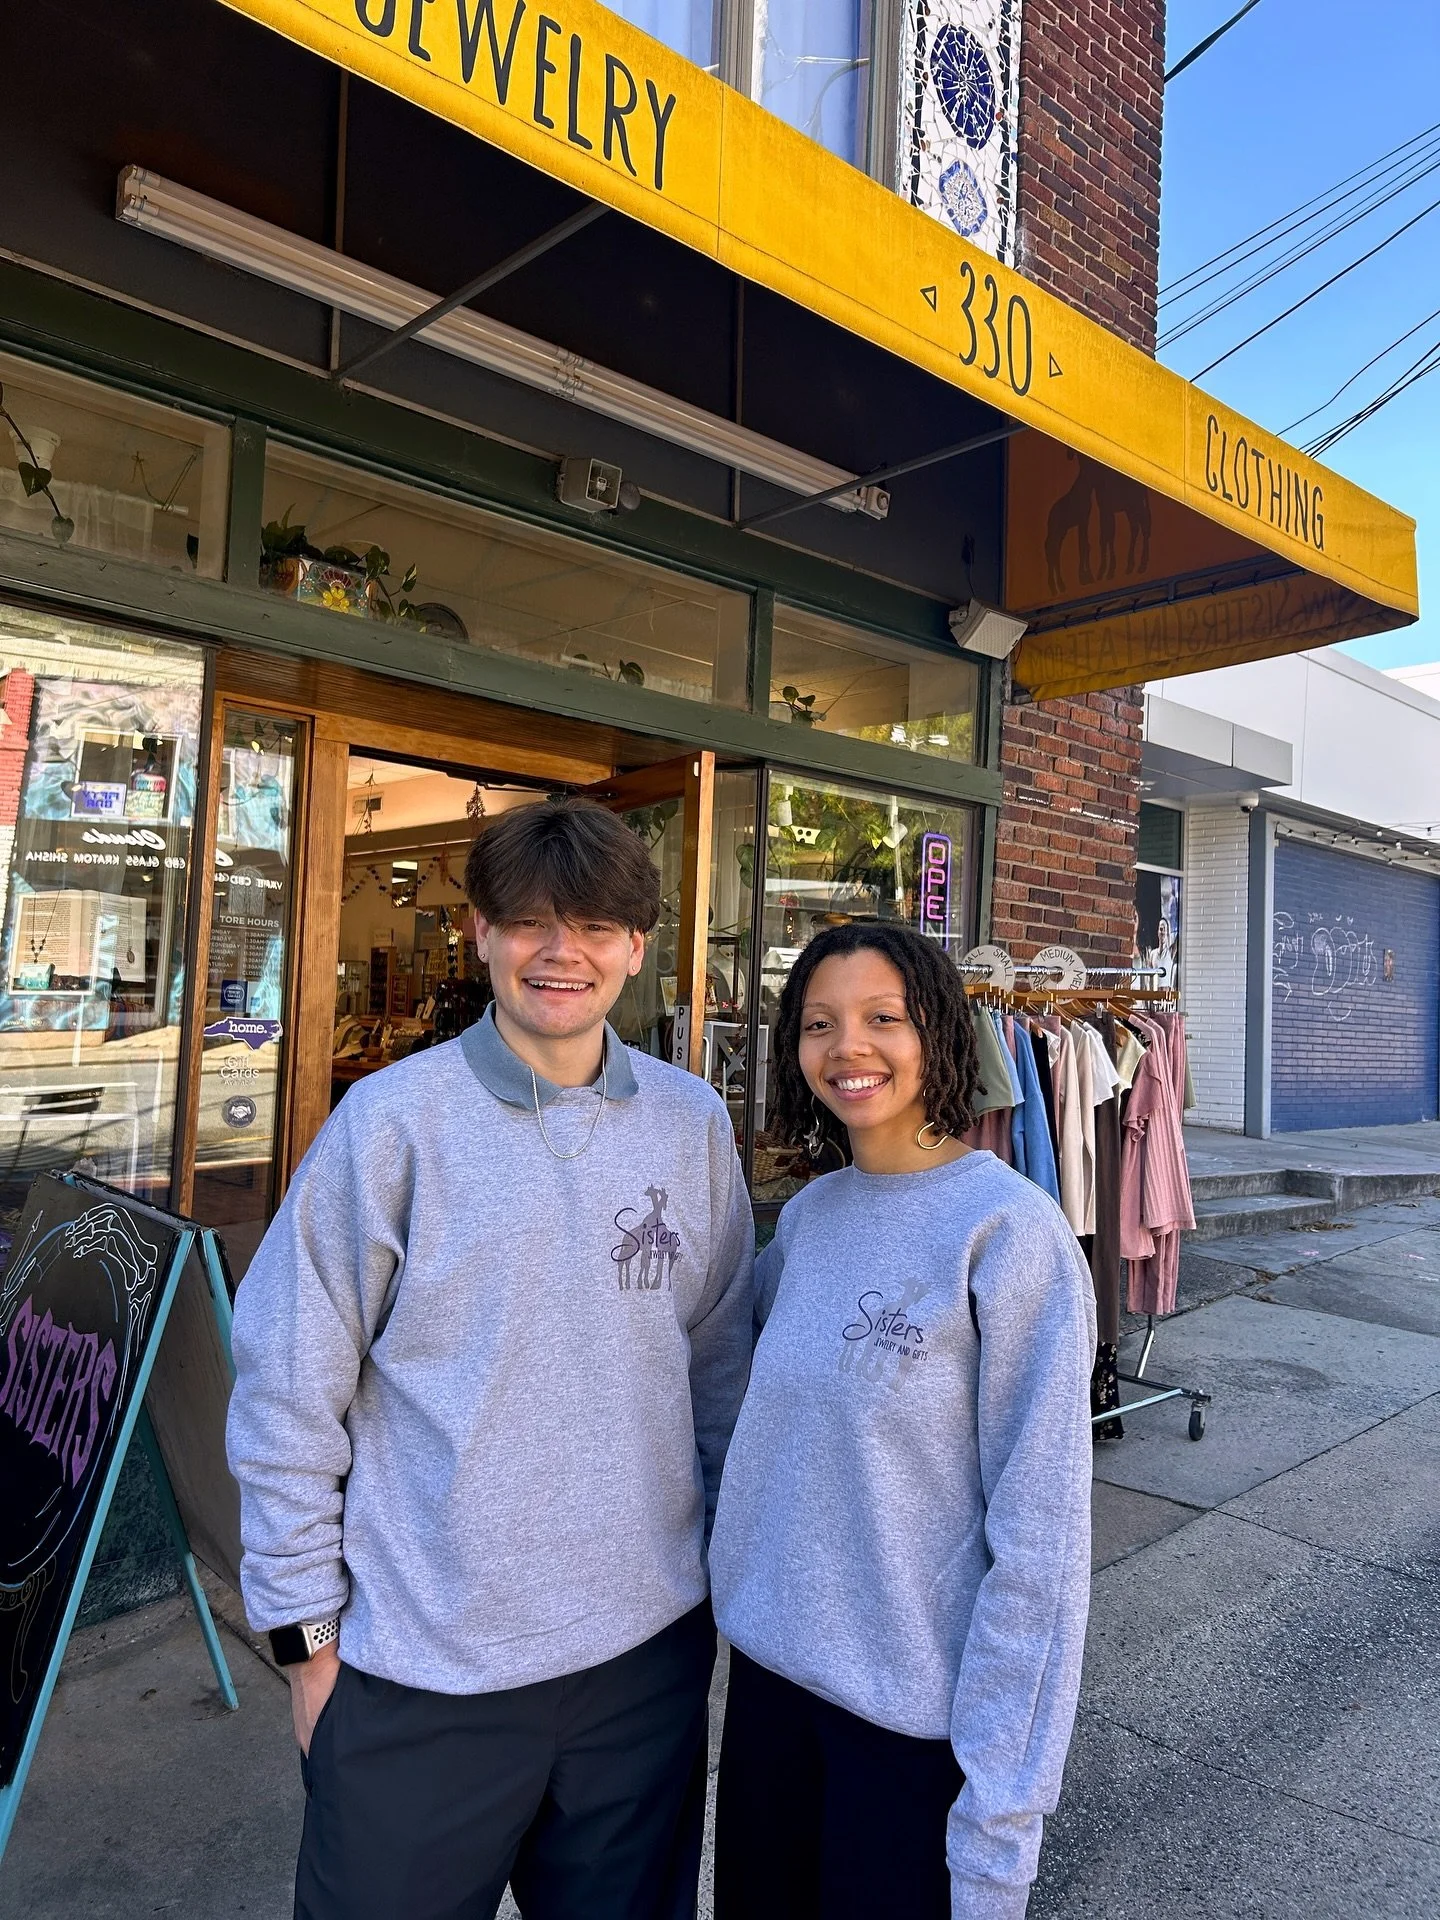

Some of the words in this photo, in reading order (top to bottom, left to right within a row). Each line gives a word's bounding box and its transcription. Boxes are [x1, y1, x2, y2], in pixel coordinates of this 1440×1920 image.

[959, 261, 1032, 397] 330
[1206, 414, 1324, 551] CLOTHING
[219, 915, 245, 925] TORE
[247, 917, 280, 928] HOURS
[925, 842, 946, 948] OPEN
[964, 948, 985, 965] MALL
[993, 948, 1014, 982] SMALL
[1040, 948, 1076, 966] MEDIUM
[1069, 969, 1085, 990] MED
[228, 1021, 268, 1034] home.
[676, 1006, 685, 1061] PUS
[220, 1066, 260, 1079] Cards
[227, 1055, 249, 1069] Gift
[611, 1207, 681, 1262] Sisters
[842, 1290, 924, 1344] Sisters
[0, 1294, 118, 1489] SISTERS
